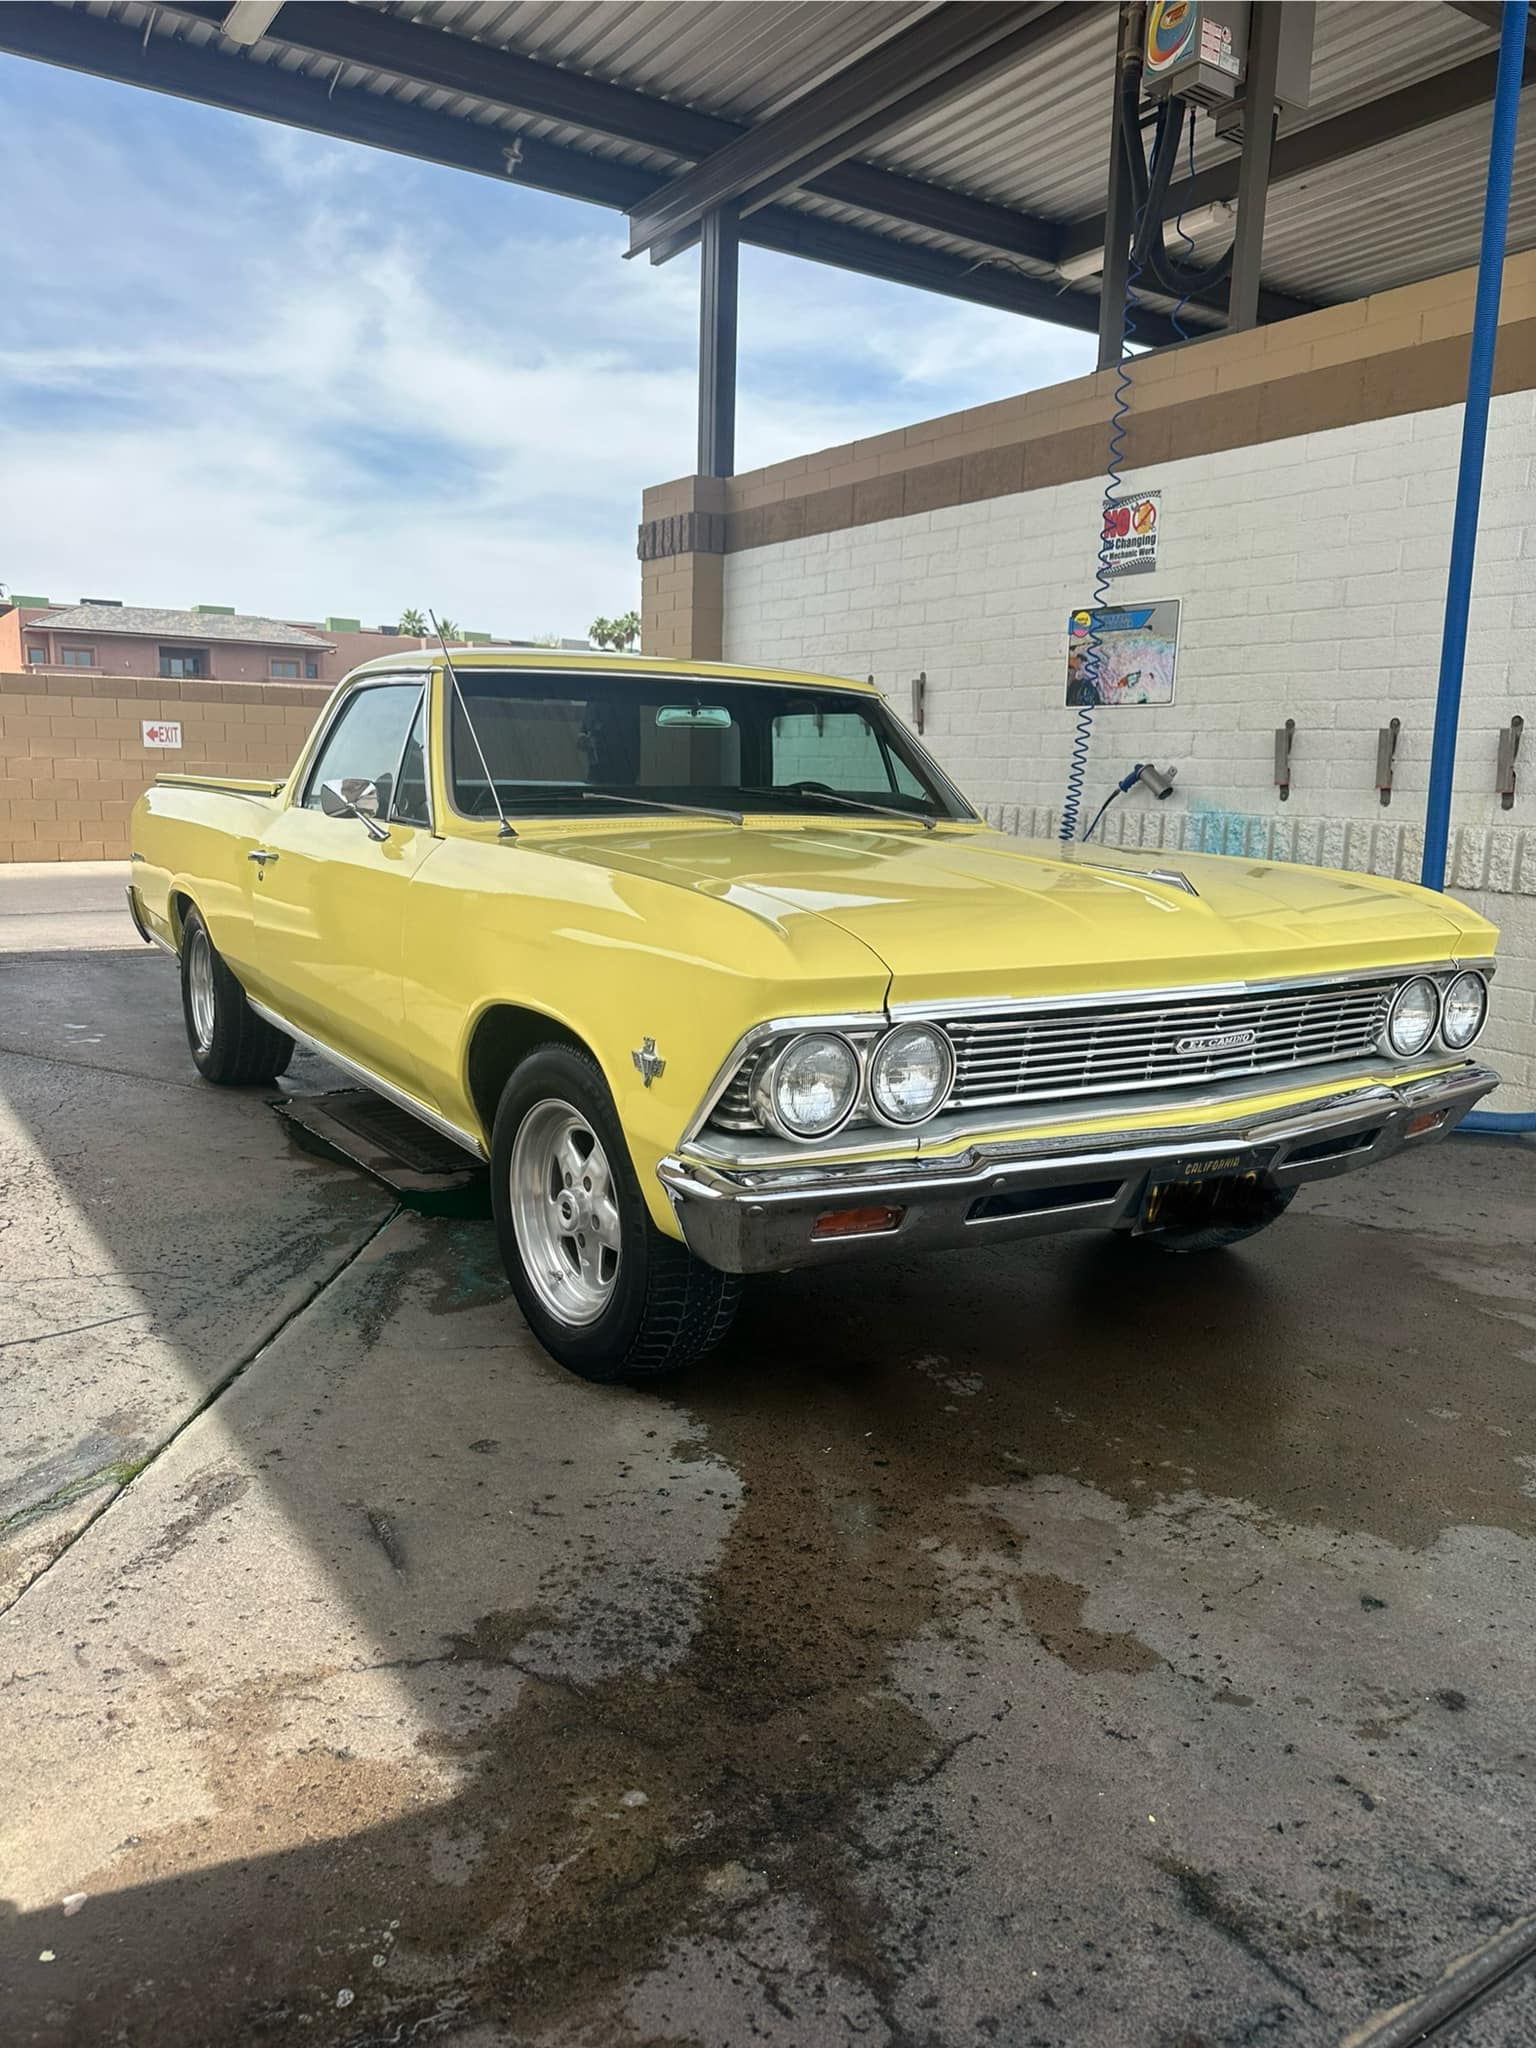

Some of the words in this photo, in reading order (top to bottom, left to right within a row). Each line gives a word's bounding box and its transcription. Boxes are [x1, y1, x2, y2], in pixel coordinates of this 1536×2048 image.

[1103, 508, 1130, 538] NO
[1115, 534, 1156, 550] Changing
[1109, 549, 1137, 560] Mechanic
[1138, 547, 1155, 556] Work
[158, 726, 178, 743] EXIT
[1188, 1039, 1206, 1049] EL
[1208, 1033, 1250, 1047] CAMINO
[1184, 1155, 1240, 1175] CALIFORNIA
